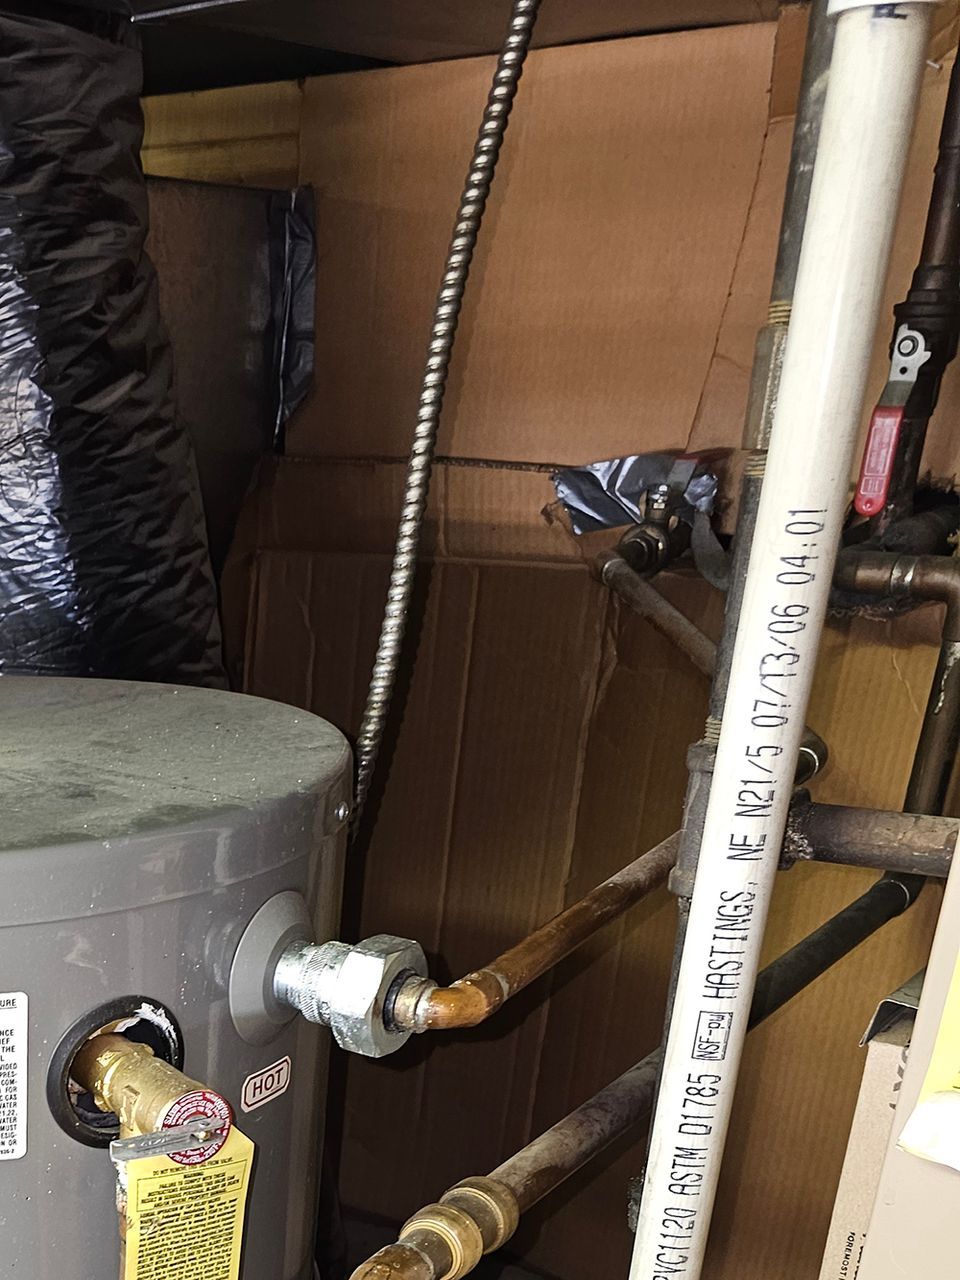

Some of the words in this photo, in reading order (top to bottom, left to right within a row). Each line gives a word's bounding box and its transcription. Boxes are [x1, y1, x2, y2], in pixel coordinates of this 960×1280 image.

[777, 507, 829, 586] 04:01
[752, 603, 810, 728] 07/13/06
[735, 743, 784, 819] N21/5
[727, 833, 768, 861] NE
[253, 1067, 284, 1098] HOT
[678, 1073, 722, 1136] D1785
[669, 1145, 709, 1196] ASTM
